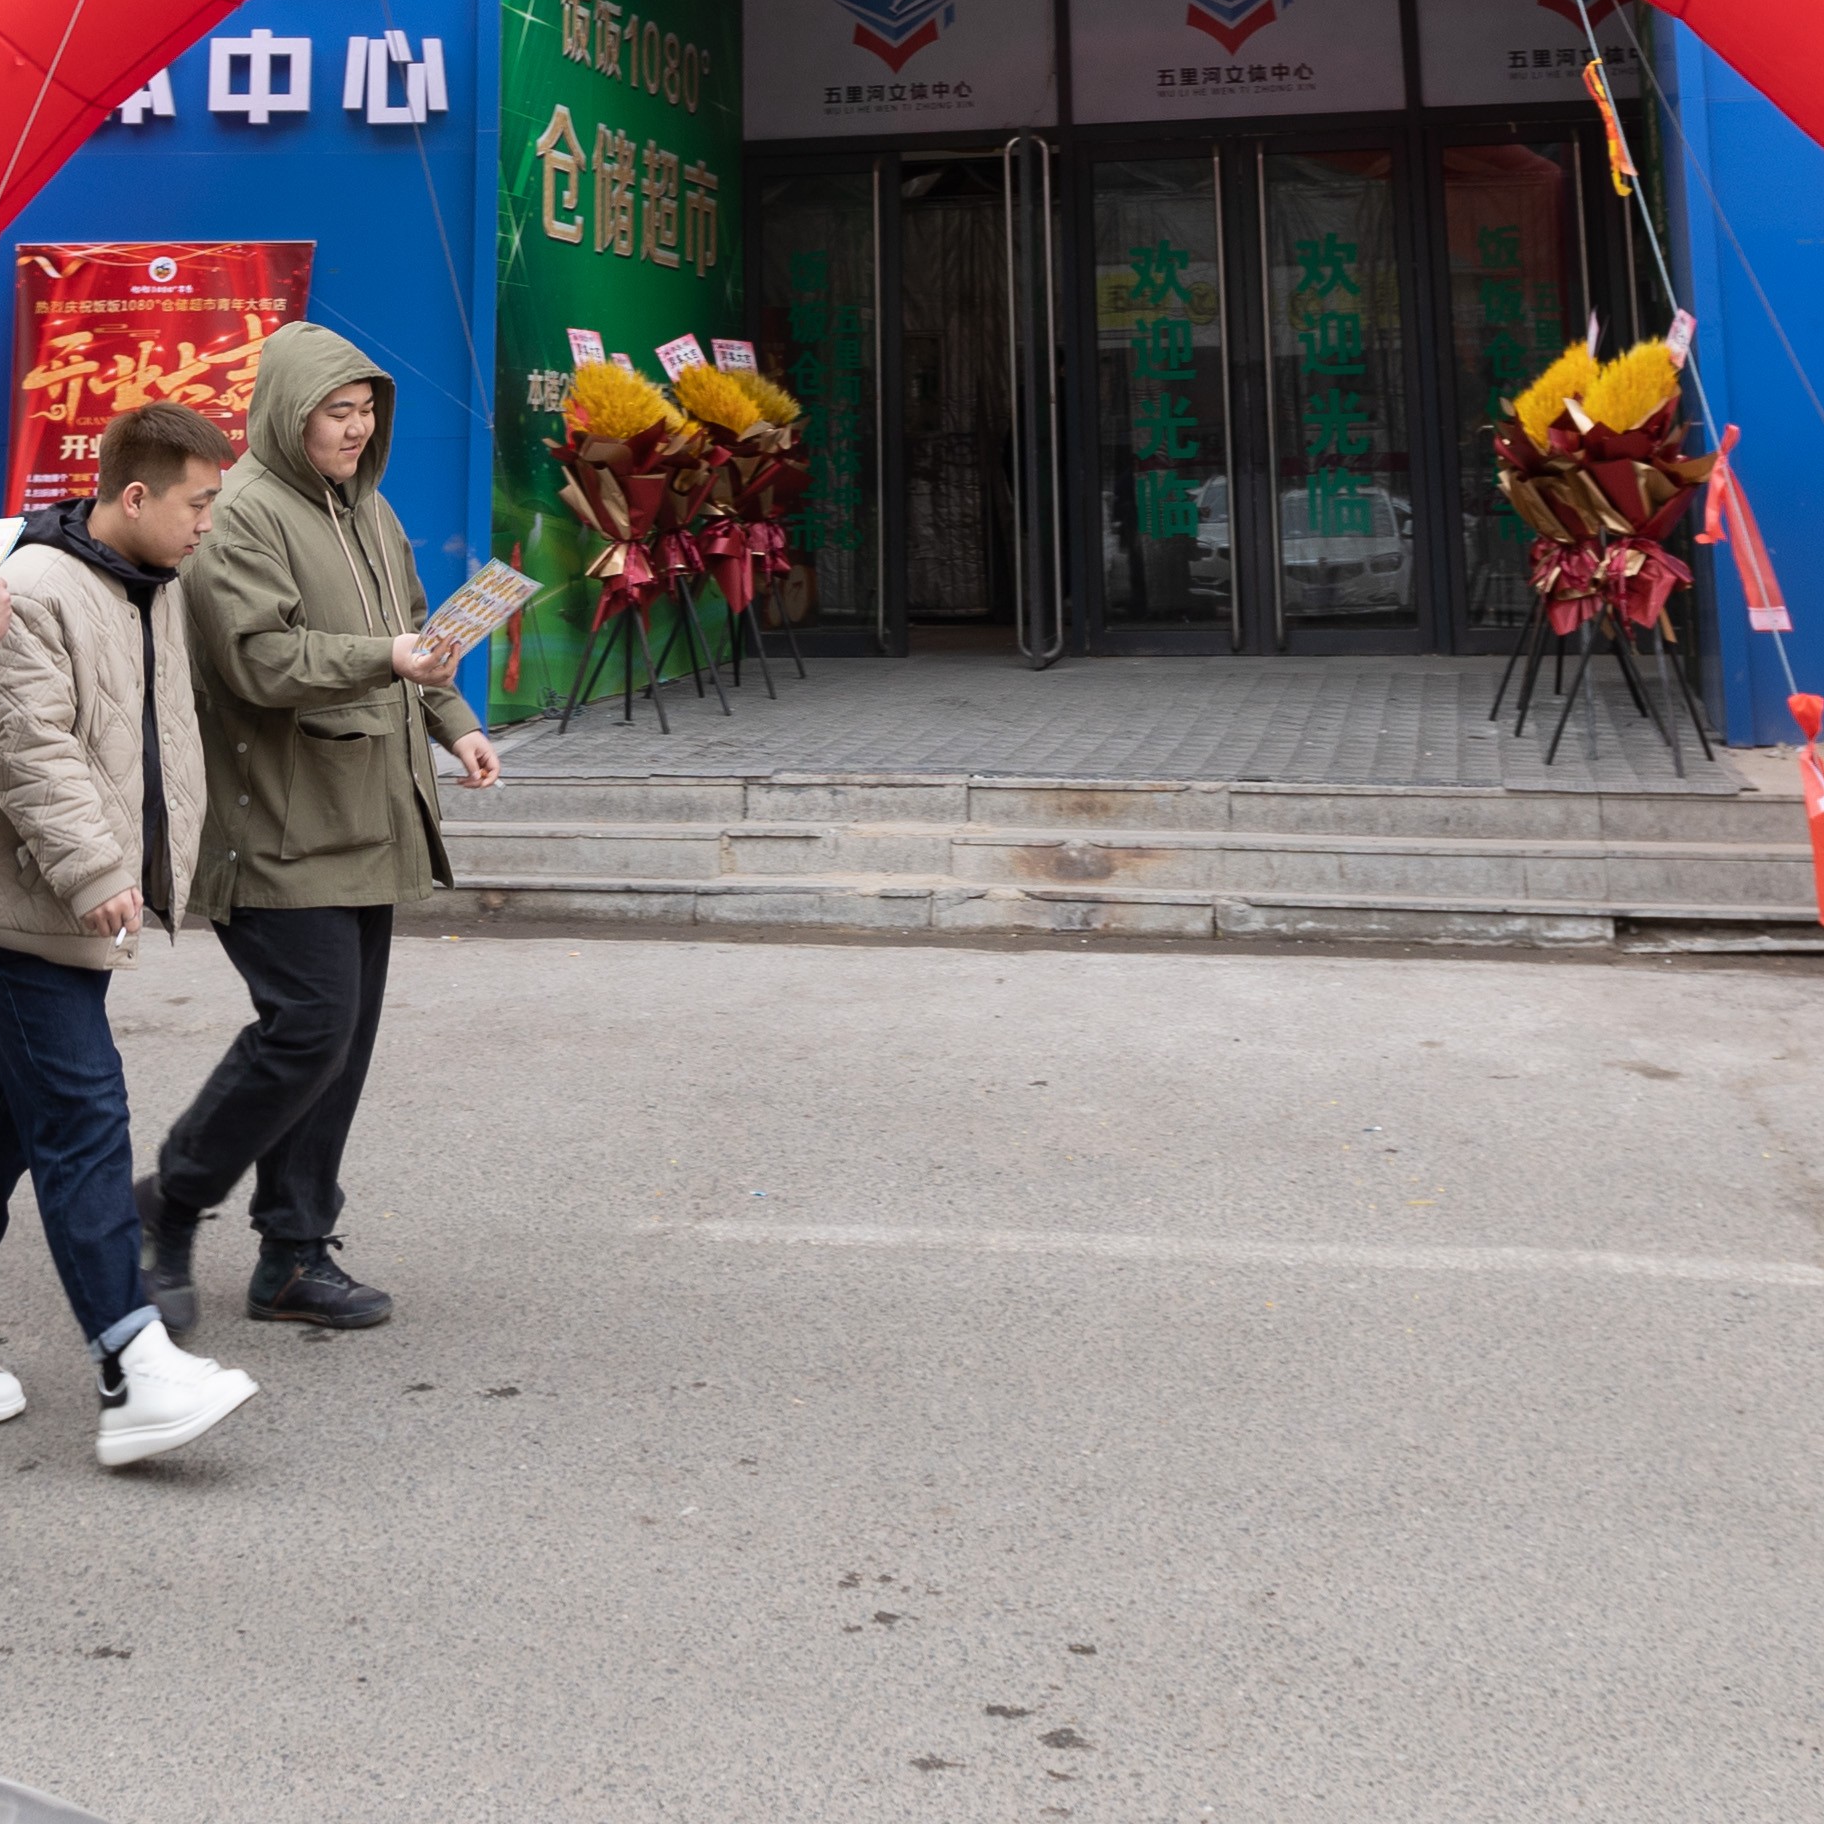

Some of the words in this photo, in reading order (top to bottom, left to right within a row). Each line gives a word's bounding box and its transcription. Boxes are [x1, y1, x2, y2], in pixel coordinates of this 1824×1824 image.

[823, 80, 973, 105] 五里河文体中心
[1156, 62, 1314, 87] 五里河文体中心
[536, 103, 720, 279] 仓储超市
[1129, 238, 1200, 540] 欢迎光临
[1294, 233, 1373, 538] 欢迎光临
